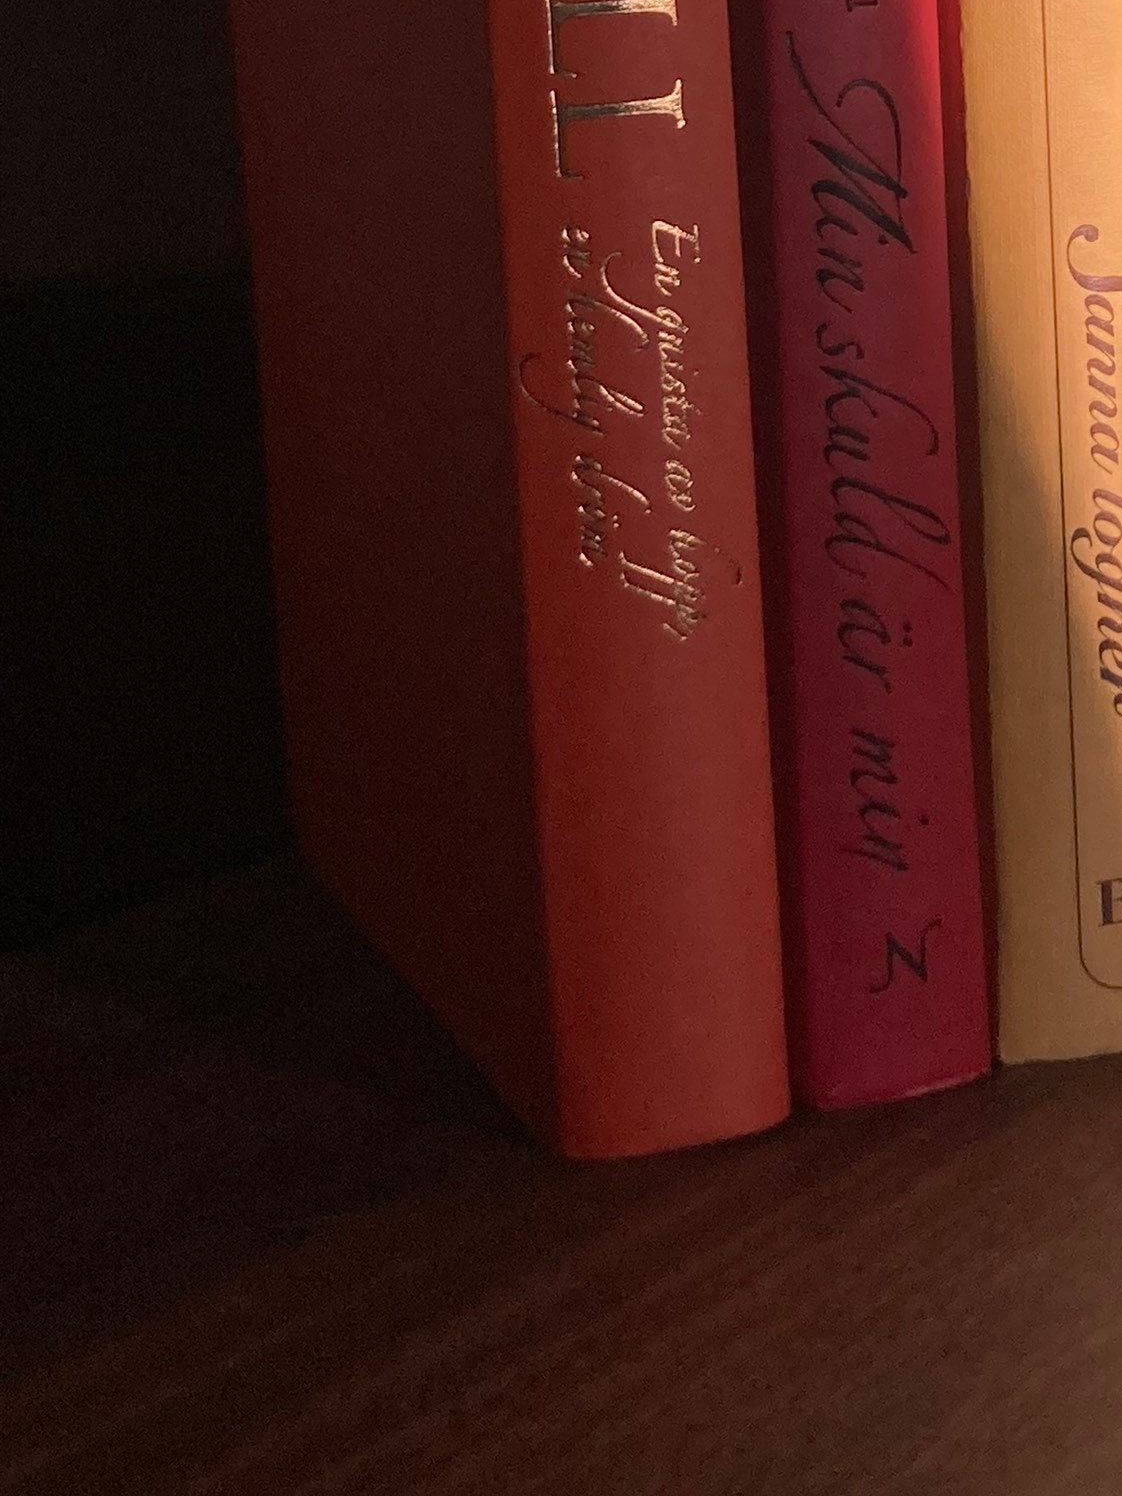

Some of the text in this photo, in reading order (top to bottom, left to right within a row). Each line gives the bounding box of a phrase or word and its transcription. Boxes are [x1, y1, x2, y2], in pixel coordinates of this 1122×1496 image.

[599, 250, 702, 451] gnista
[651, 220, 701, 297] En
[518, 225, 653, 569] en hemlig dröm
[664, 458, 696, 513] av
[784, 30, 952, 872] Min skuld är min
